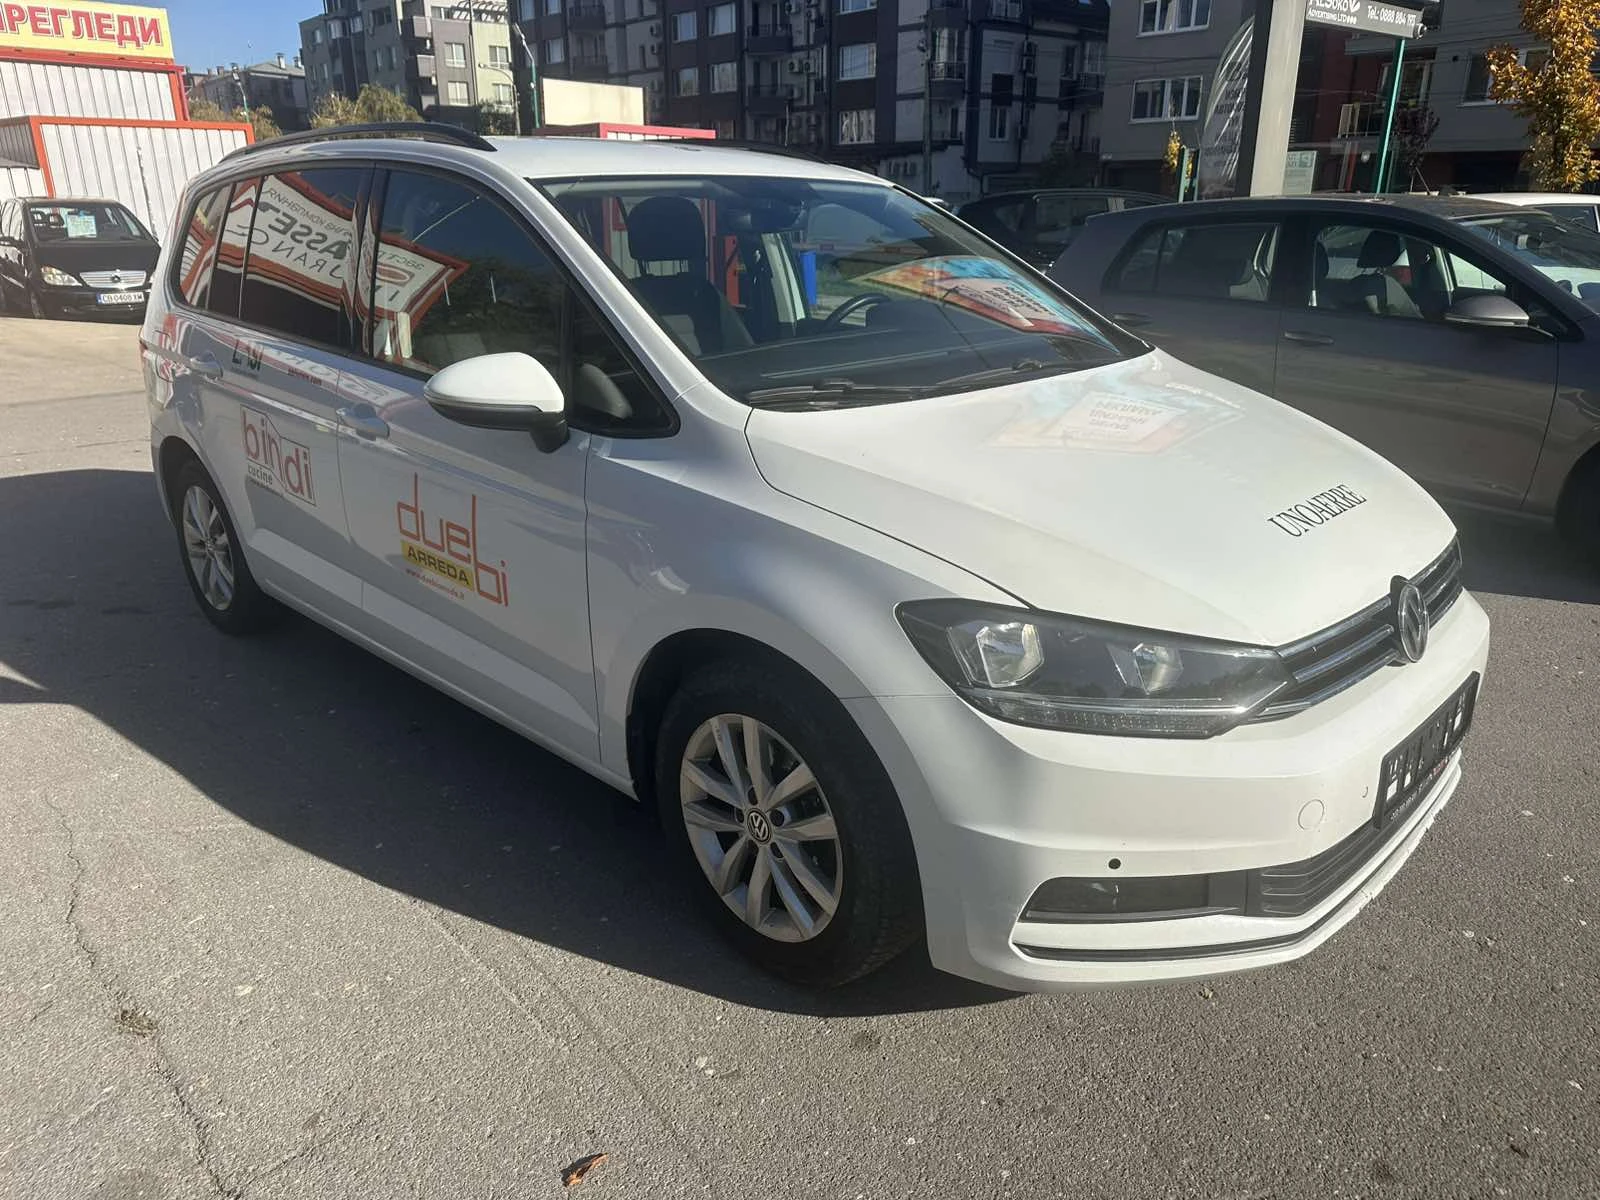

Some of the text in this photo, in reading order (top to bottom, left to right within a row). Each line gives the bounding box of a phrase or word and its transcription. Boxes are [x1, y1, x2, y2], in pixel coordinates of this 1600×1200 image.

[242, 409, 313, 500] bindi
[397, 472, 508, 607] duebi
[1266, 484, 1367, 537] UNOAERRE
[407, 545, 471, 586] ARREDA
